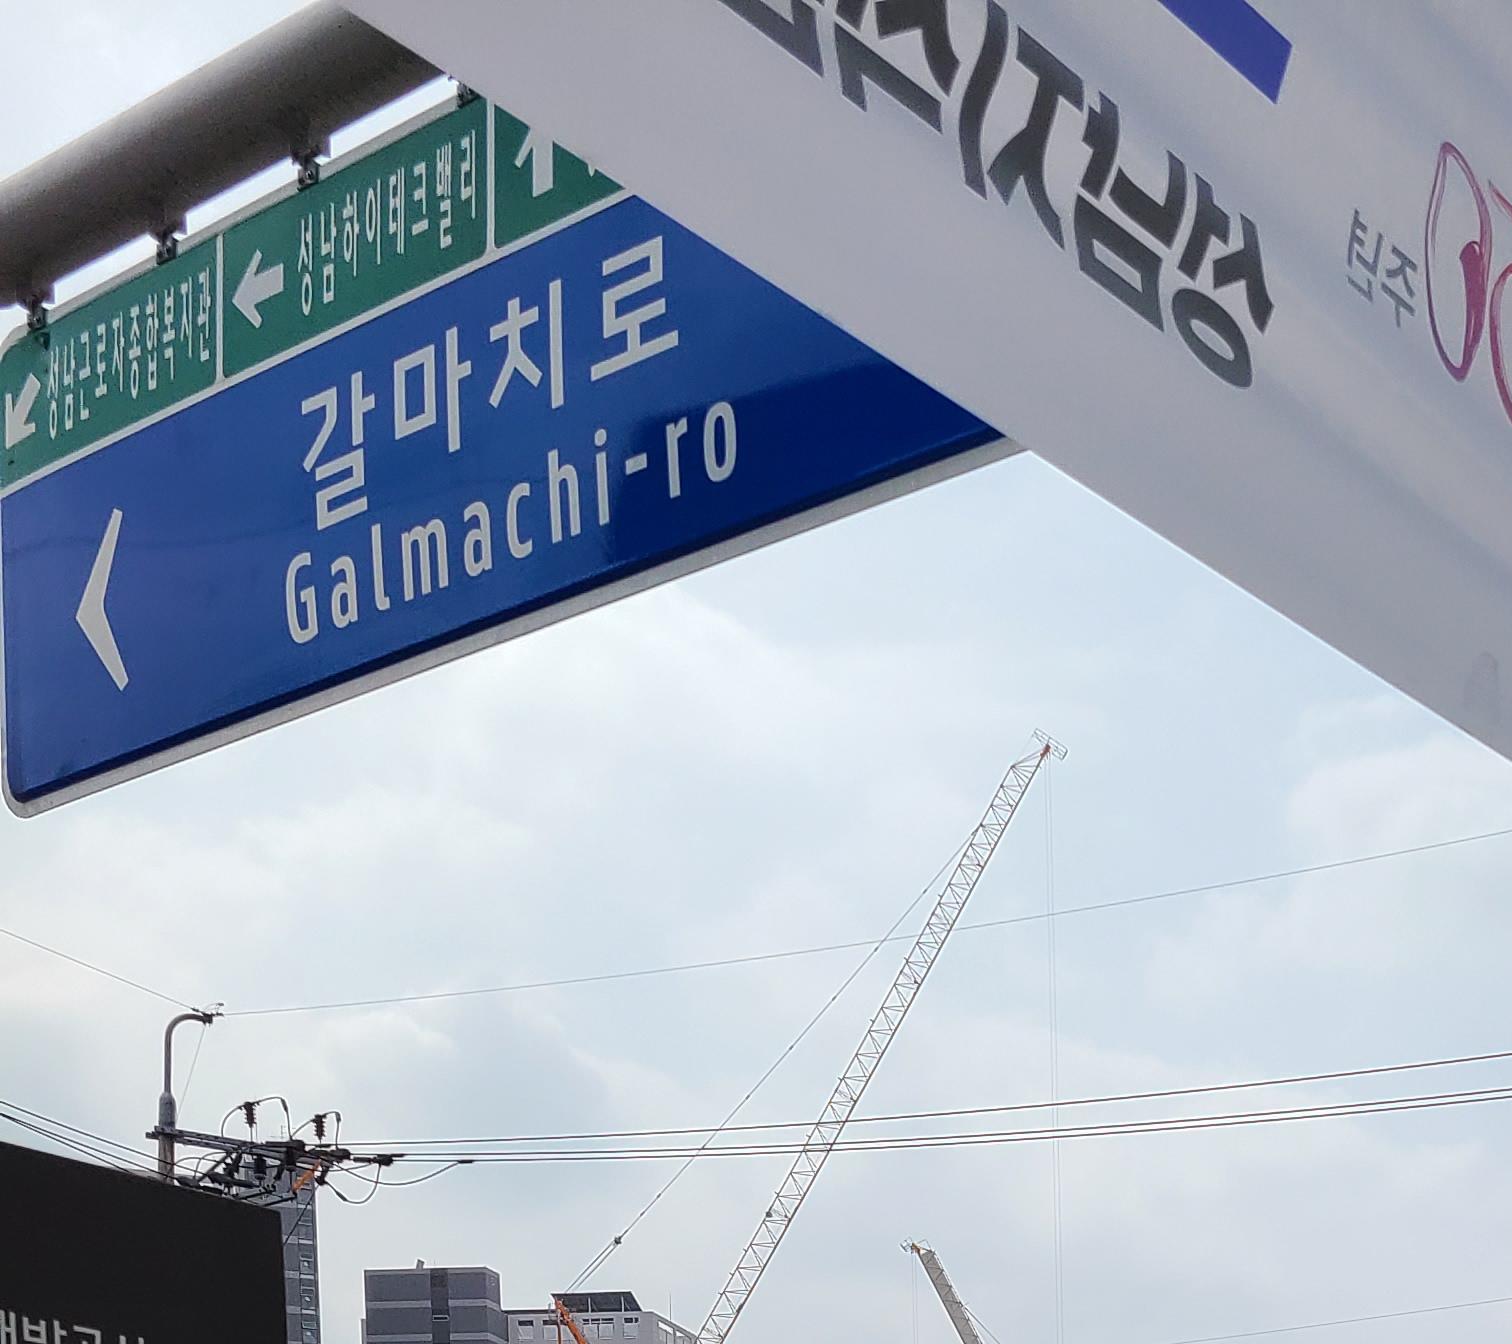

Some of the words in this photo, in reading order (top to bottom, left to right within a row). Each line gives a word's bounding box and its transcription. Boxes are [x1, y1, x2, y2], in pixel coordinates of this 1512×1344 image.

[297, 129, 476, 316] 성남하이테크밸리
[46, 266, 212, 440] 성남근로자종합복지관
[299, 235, 680, 530] 갈마치로
[284, 400, 739, 645] Galmachi-ro
